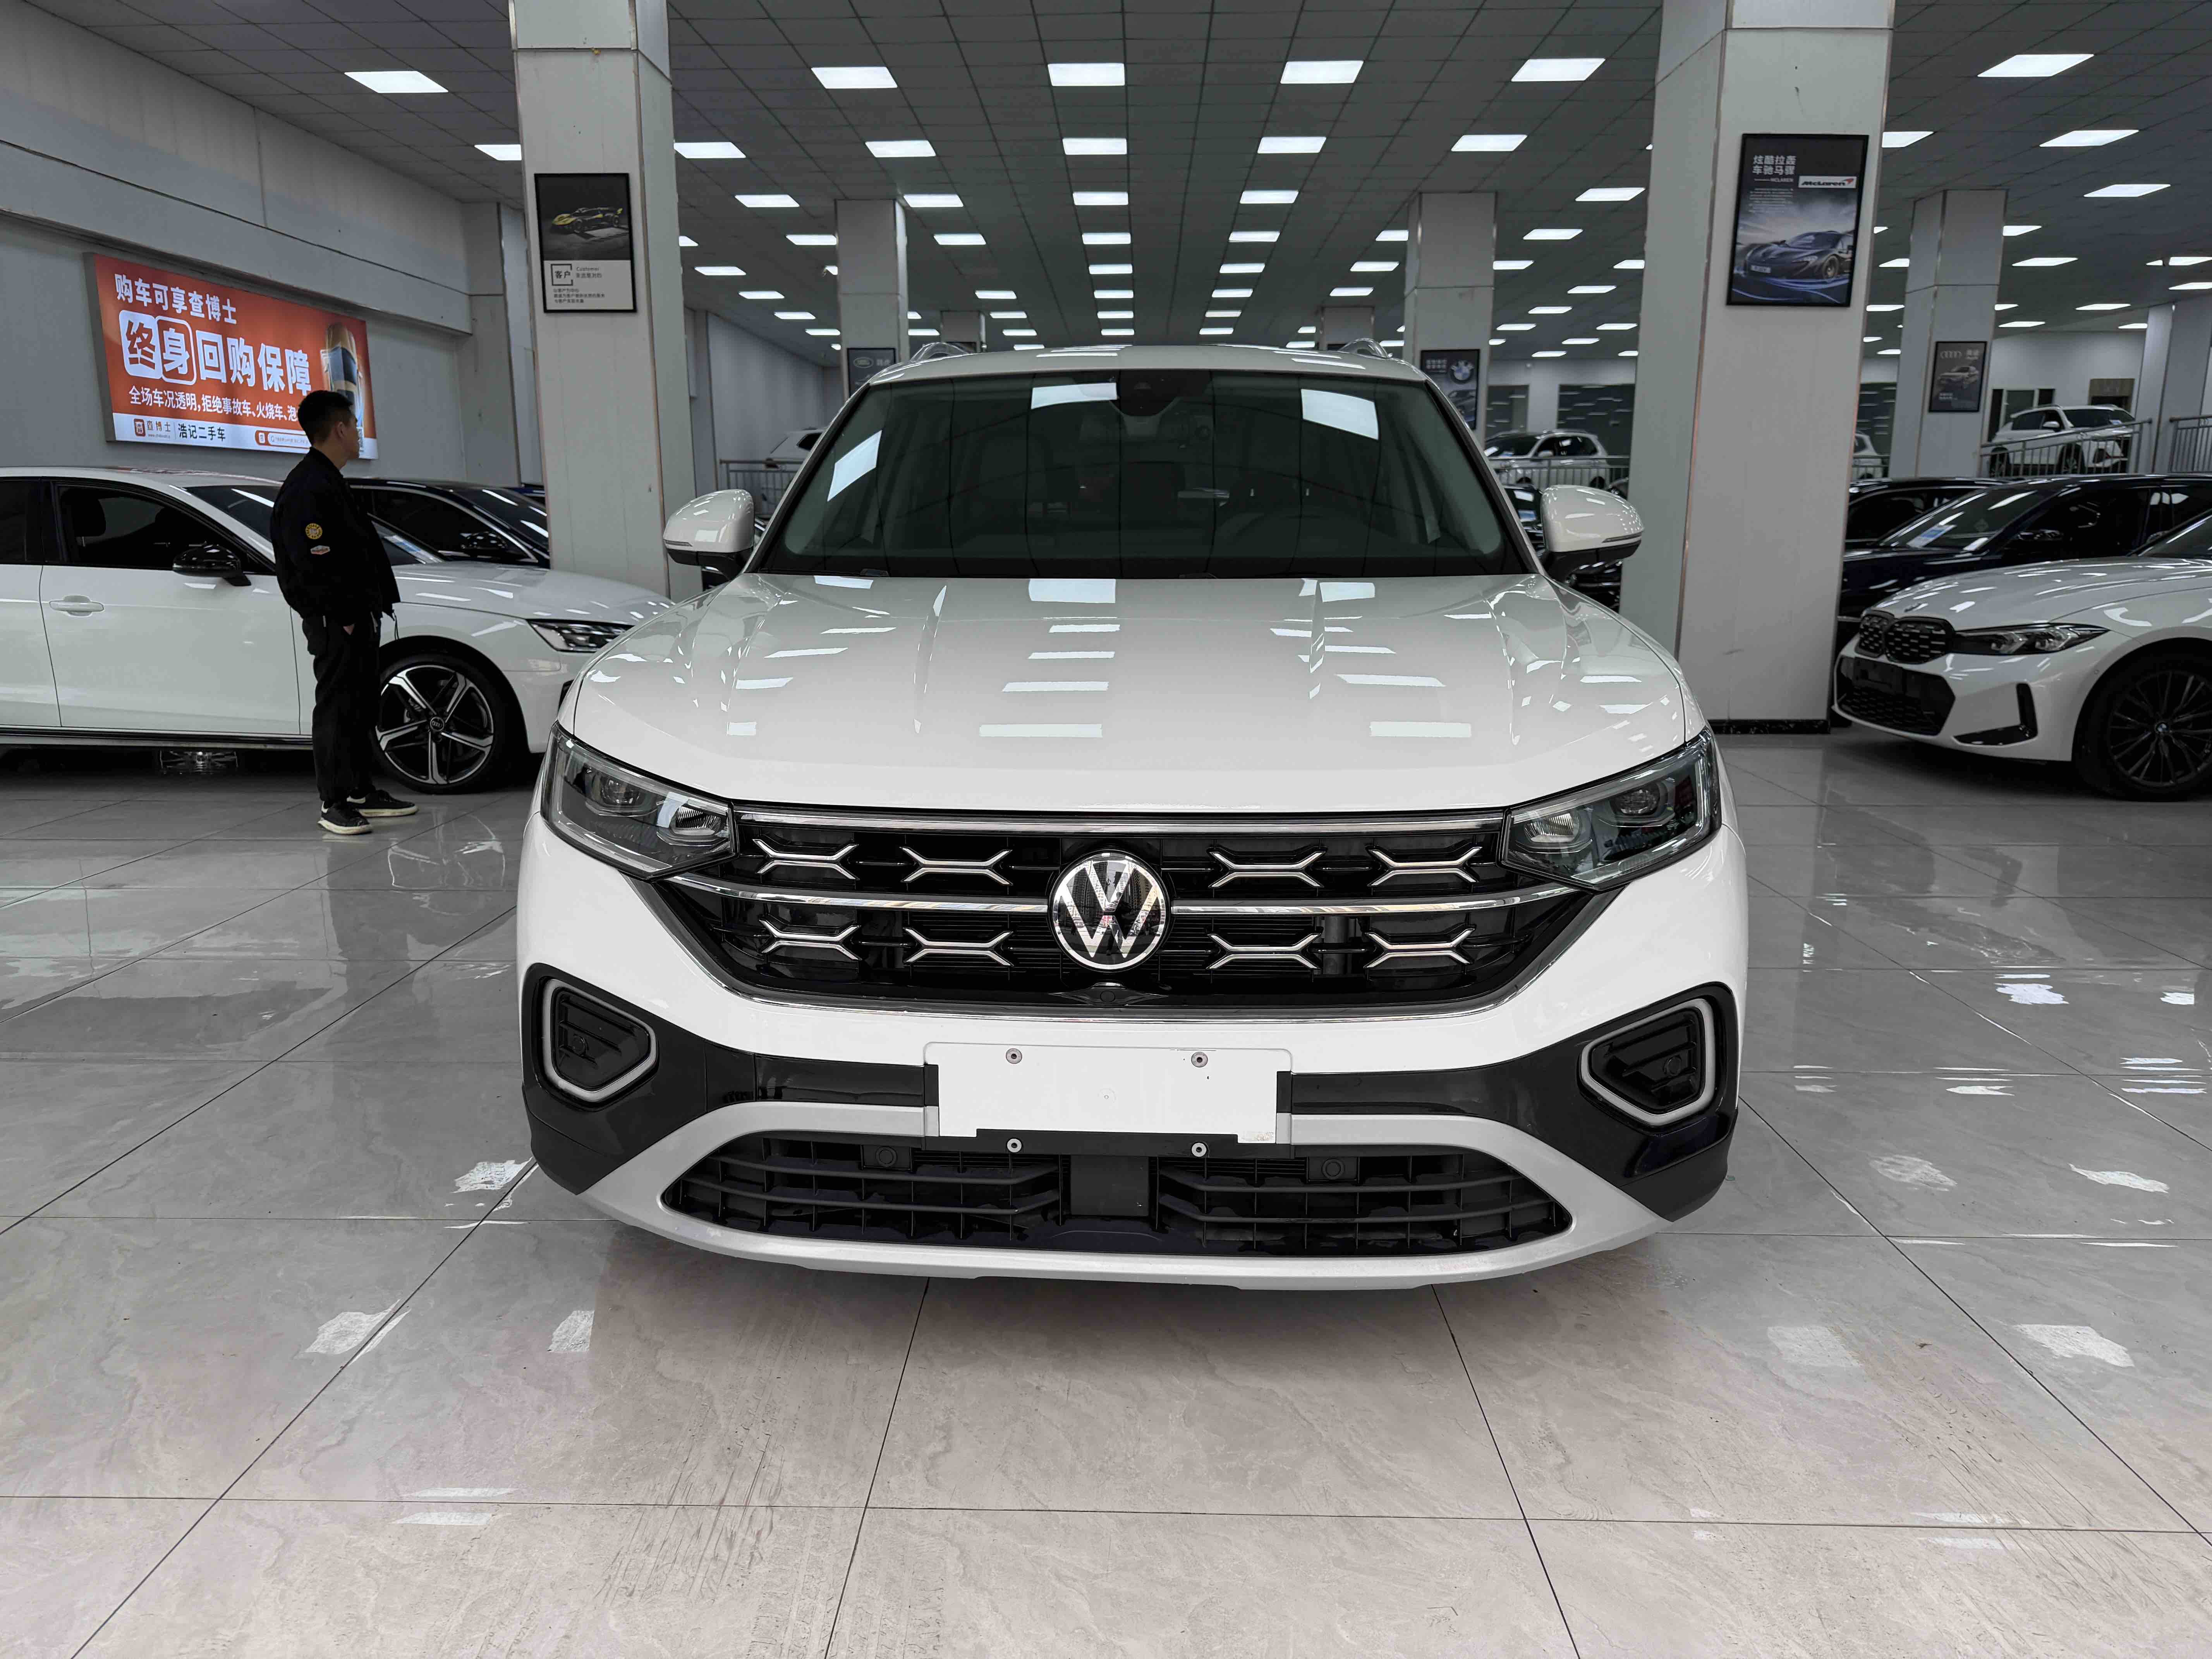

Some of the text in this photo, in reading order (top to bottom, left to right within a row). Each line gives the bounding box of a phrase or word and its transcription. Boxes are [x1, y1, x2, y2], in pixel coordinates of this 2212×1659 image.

[555, 271, 570, 279] 客户
[115, 273, 236, 325] 购车可享查博士
[125, 318, 311, 396] 终身回购保障
[129, 385, 298, 422] 全场车况透明,拒绝事故车、火烧车、泡
[178, 422, 225, 442] 浩记二手车
